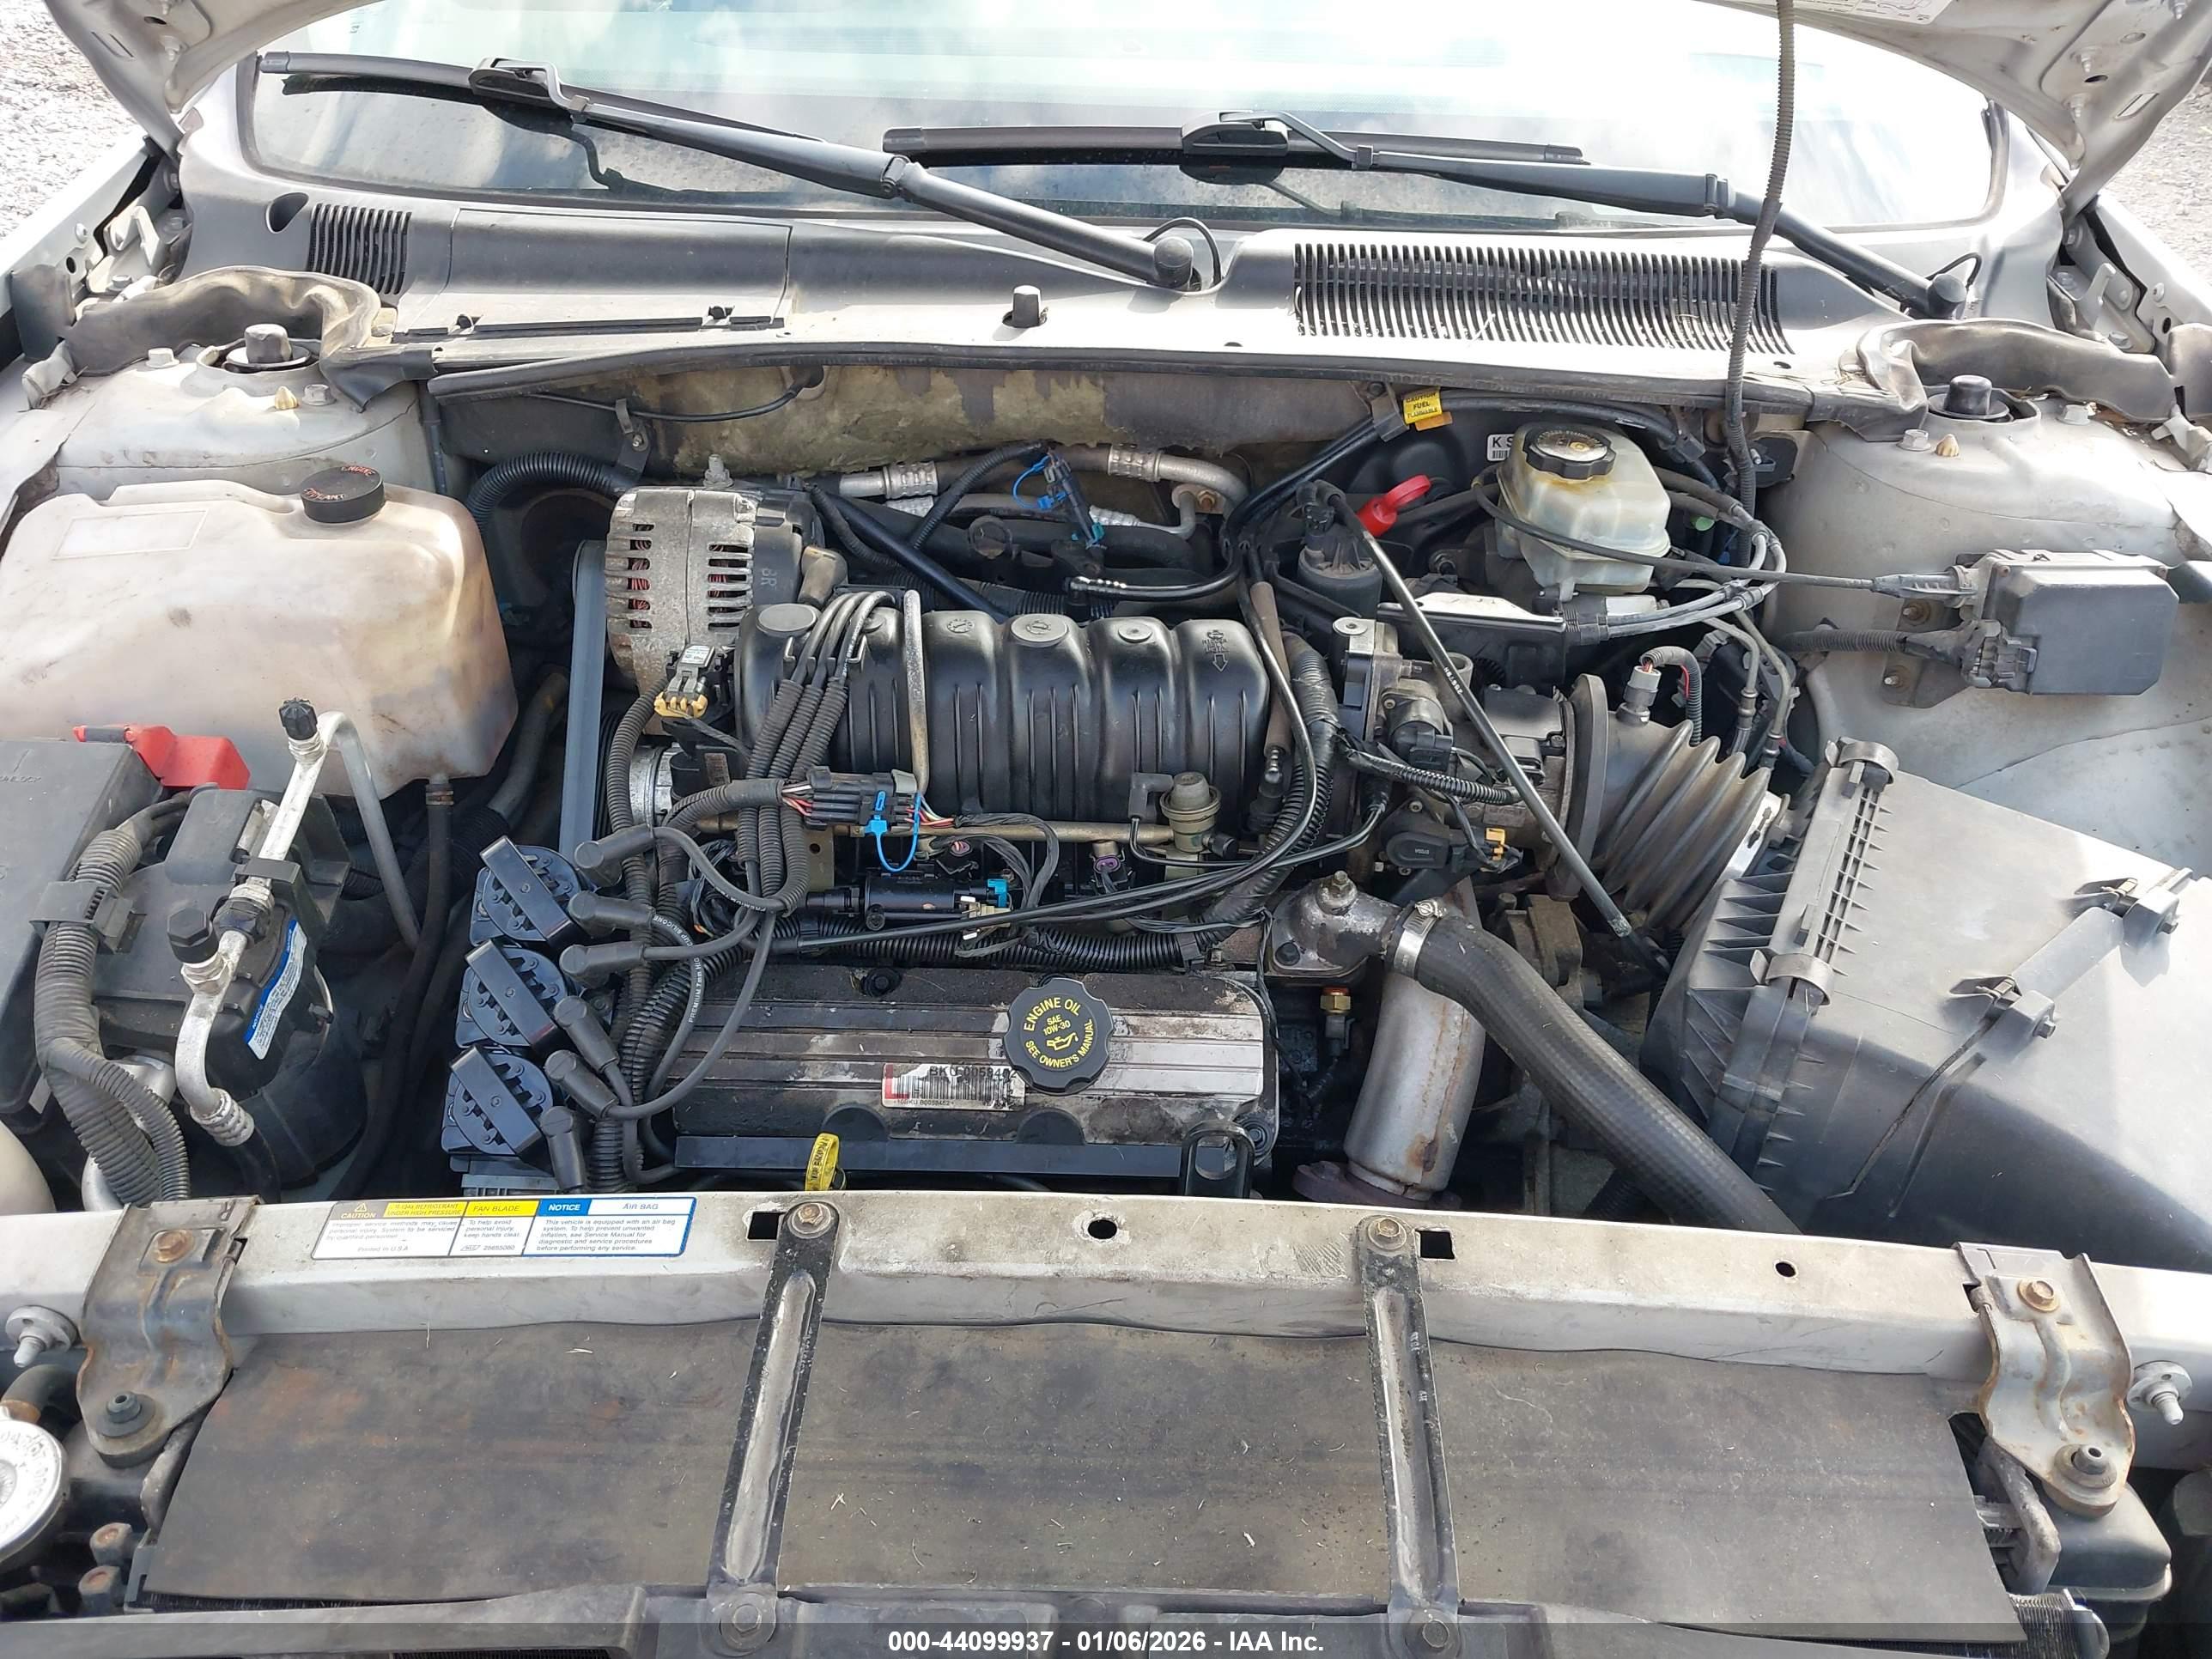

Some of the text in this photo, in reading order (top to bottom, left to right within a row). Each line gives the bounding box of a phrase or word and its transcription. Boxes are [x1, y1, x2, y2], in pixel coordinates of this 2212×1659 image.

[1413, 401, 1429, 410] FUEL
[1492, 437, 1501, 448] K
[653, 915, 683, 935] SILICONE
[688, 989, 702, 1023] PREMIUM
[1023, 997, 1081, 1031] ENGINE OIL
[1043, 1020, 1071, 1036] 10W-30
[1047, 1015, 1063, 1026] SAE
[1025, 1018, 1094, 1068] SEE OWNER'S MANUAL
[548, 1203, 581, 1212] NOTICE
